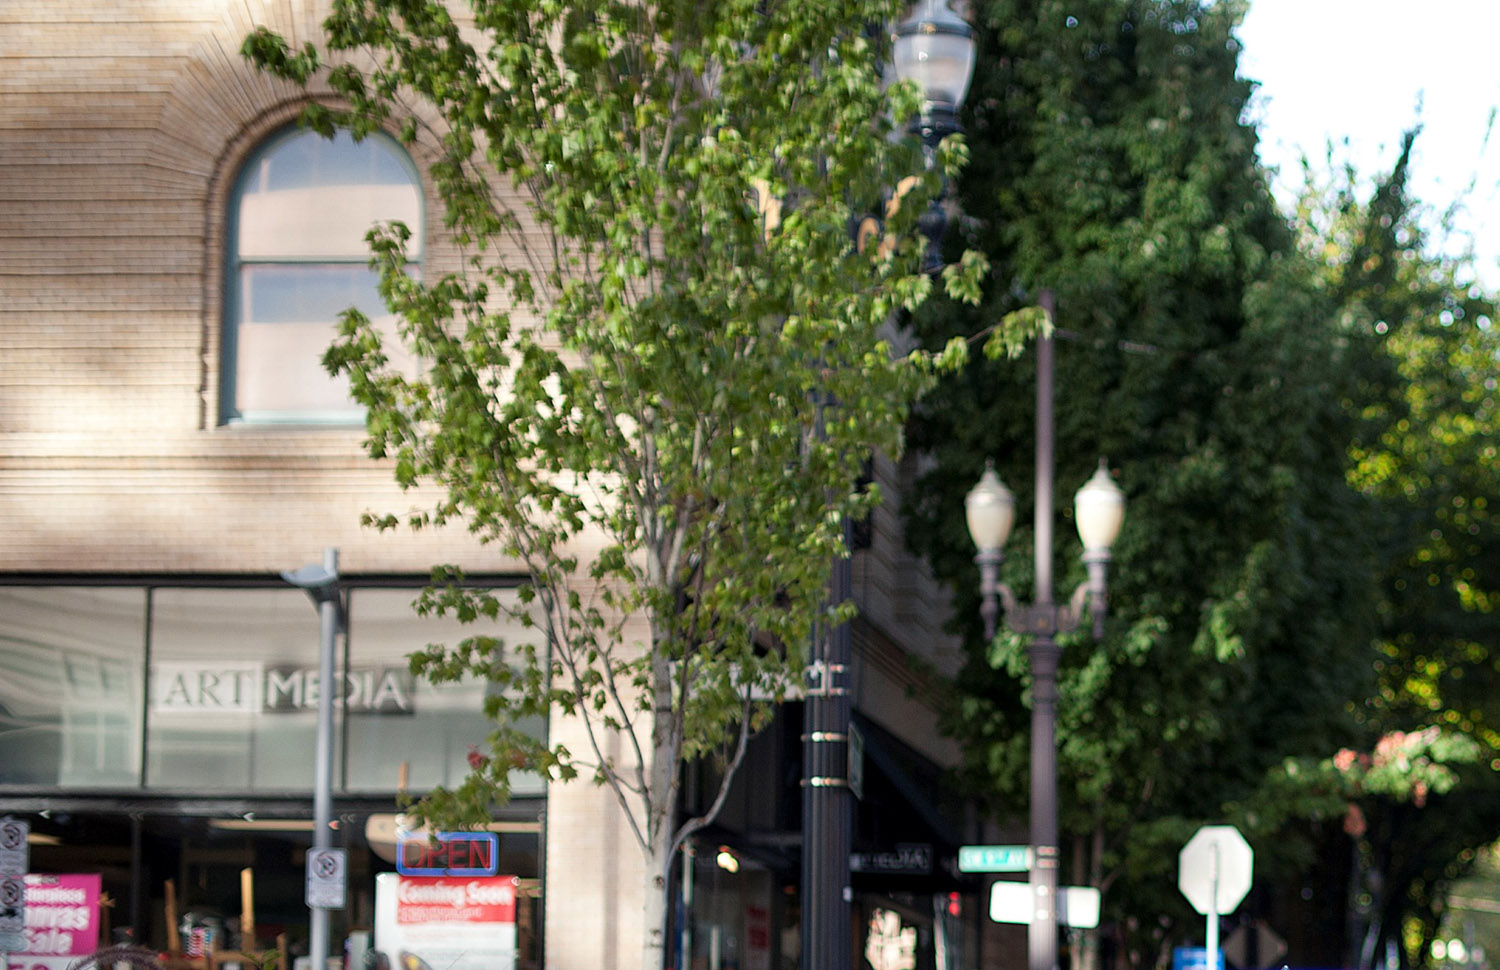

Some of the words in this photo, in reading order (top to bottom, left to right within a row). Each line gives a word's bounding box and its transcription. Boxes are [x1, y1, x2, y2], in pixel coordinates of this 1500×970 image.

[164, 668, 250, 707] ART
[267, 668, 407, 711] MEDIA
[402, 838, 491, 870] OPEN
[400, 880, 466, 910] Coming
[466, 880, 512, 906] Soon
